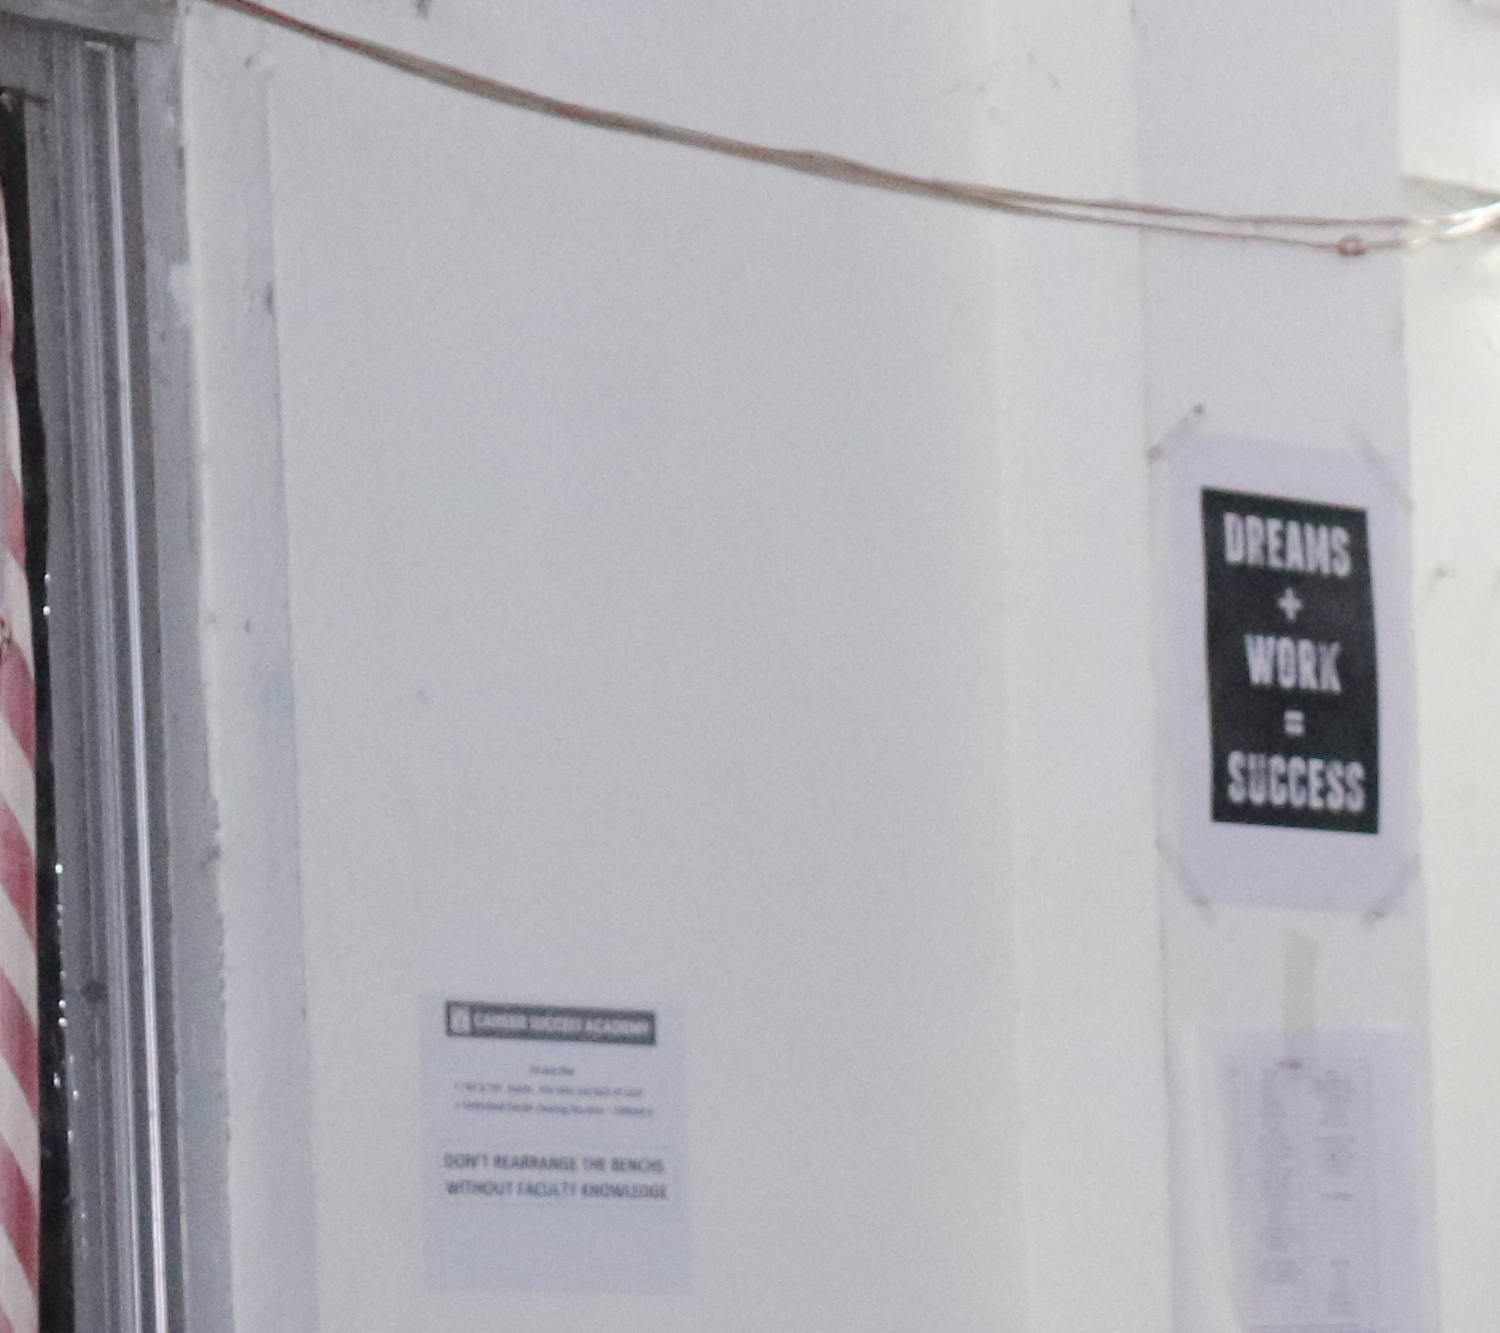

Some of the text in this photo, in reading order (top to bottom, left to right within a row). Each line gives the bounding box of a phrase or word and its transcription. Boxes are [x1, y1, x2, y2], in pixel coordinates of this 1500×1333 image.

[1222, 510, 1352, 578] DREAMS
[1243, 632, 1343, 693] WORK
[1226, 749, 1367, 813] SUCCESS
[443, 1153, 665, 1173] DON'T REARRANGE THE BENCHS
[445, 1180, 668, 1199] WITHOUT FACULTY KNOWLEDGE
